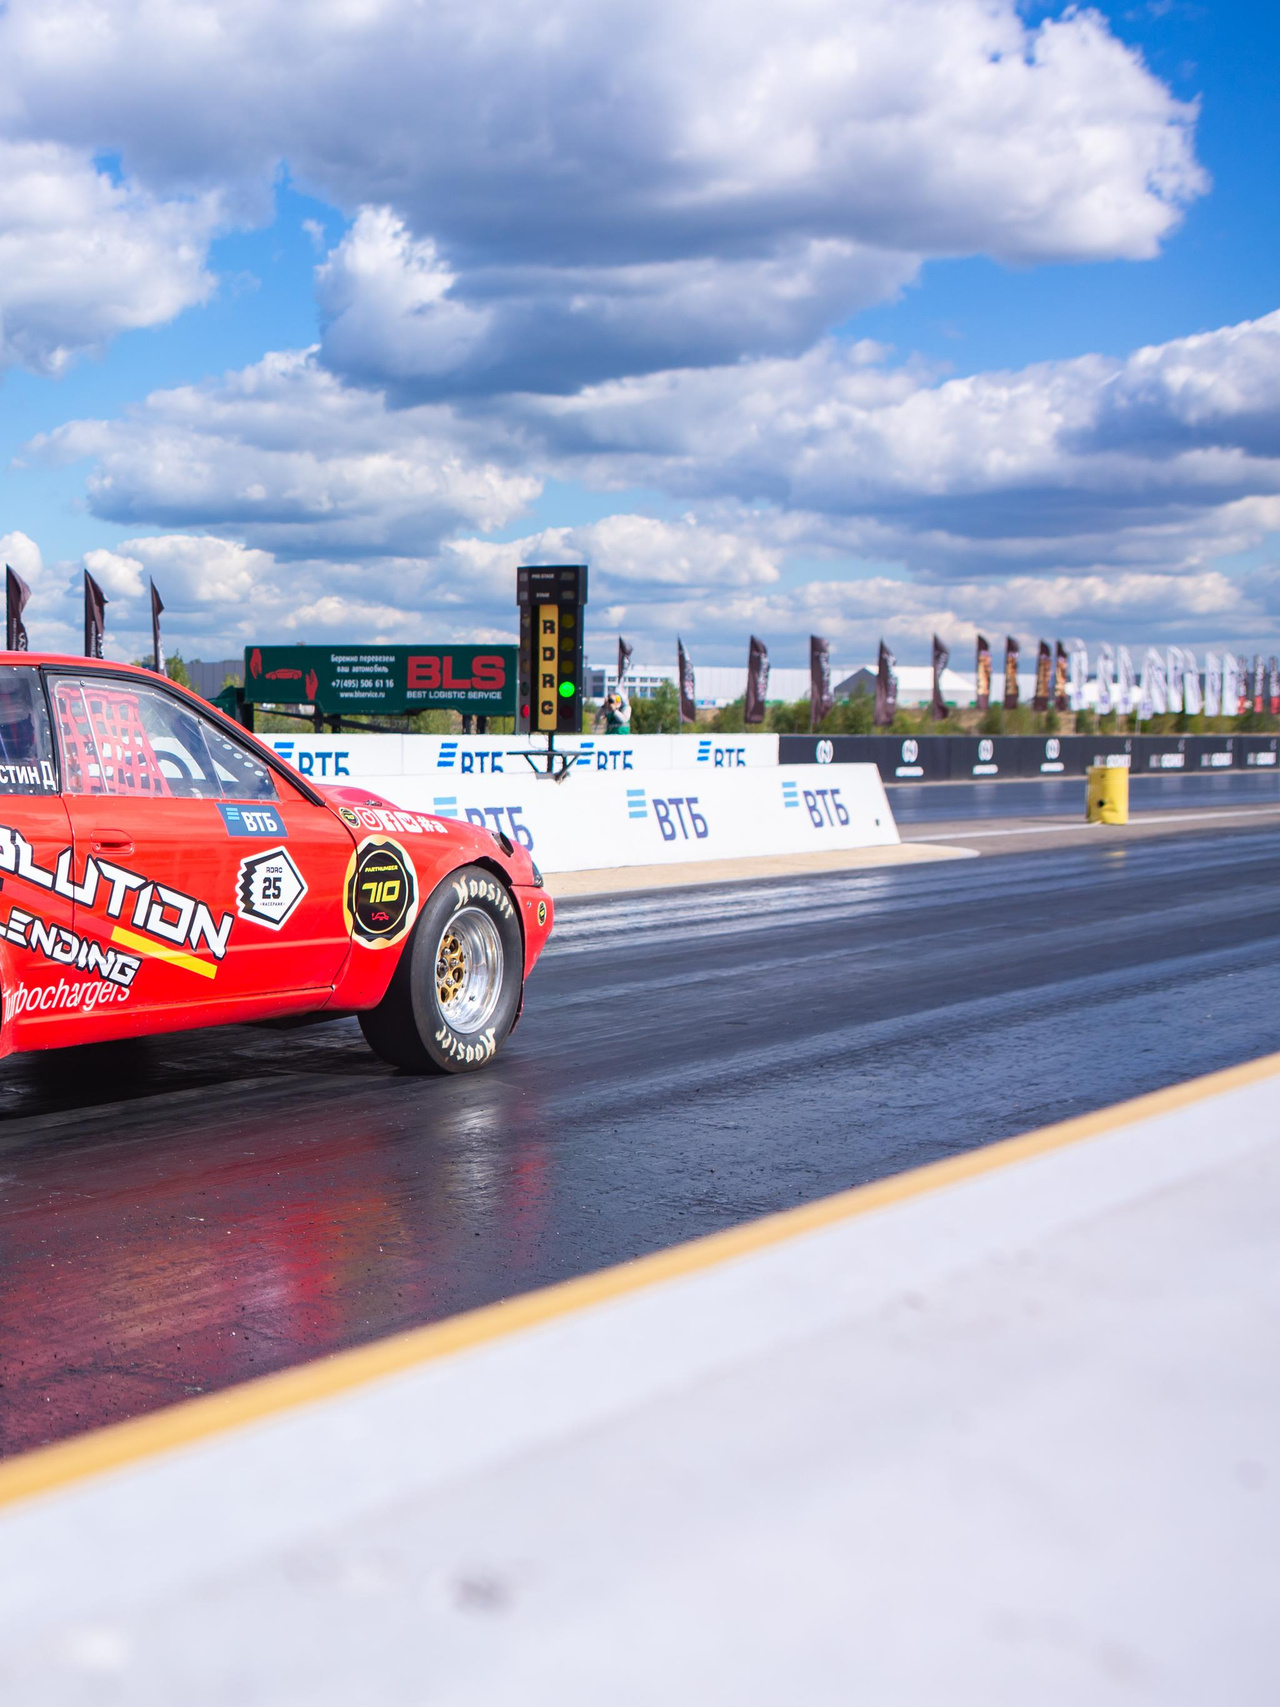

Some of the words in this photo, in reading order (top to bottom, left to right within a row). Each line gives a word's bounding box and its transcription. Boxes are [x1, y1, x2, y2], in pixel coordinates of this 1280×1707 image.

[331, 653, 359, 663] Бережно
[359, 655, 396, 663] перевезем
[351, 664, 389, 673] автомобиль
[360, 679, 373, 688] 506
[375, 679, 384, 688] 61
[385, 679, 395, 688] 16
[406, 655, 506, 690] BLS
[406, 691, 427, 699] BEST
[428, 691, 466, 699] LOGISTIC
[467, 691, 503, 700] SERVICE
[40, 760, 58, 791] Д
[652, 797, 709, 841] ВТБ
[803, 788, 850, 829] ВТБ
[240, 811, 279, 833] ВТБ
[261, 876, 282, 900] 25
[361, 879, 401, 904] 710
